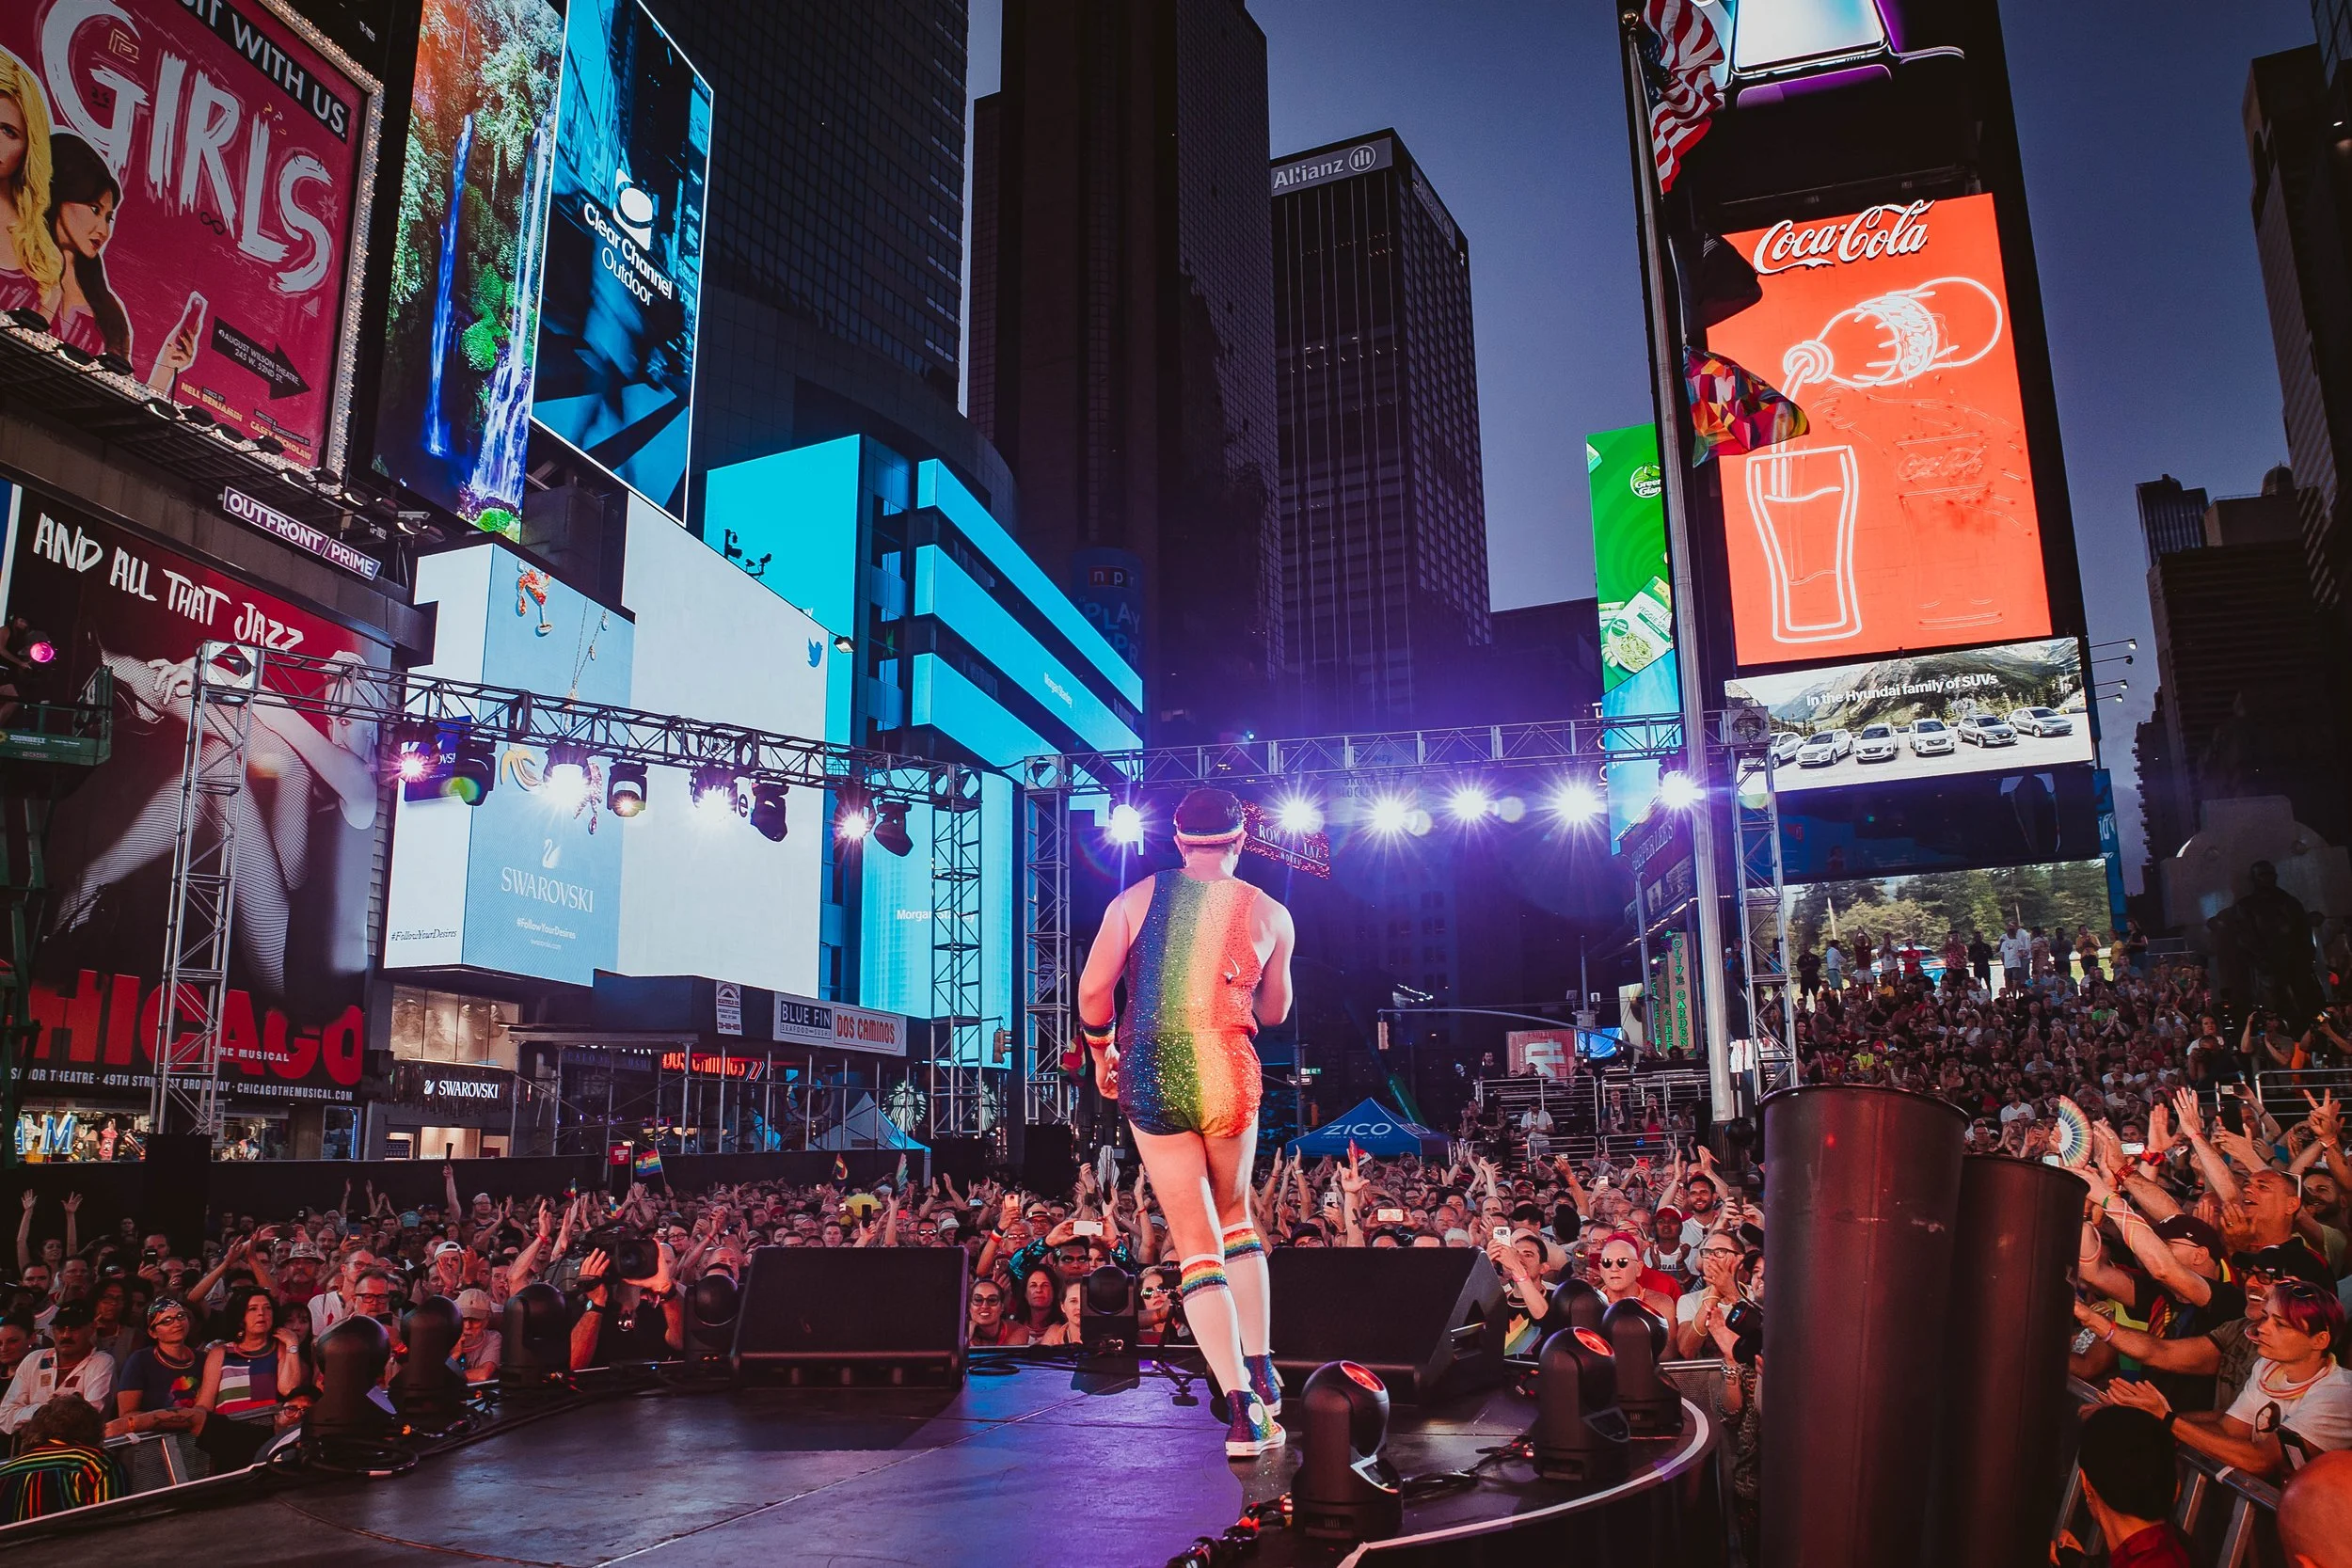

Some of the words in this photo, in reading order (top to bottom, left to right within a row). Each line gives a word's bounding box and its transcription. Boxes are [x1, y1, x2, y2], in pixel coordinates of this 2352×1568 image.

[232, 13, 306, 102] WITH
[313, 85, 346, 138] US.
[40, 0, 333, 293] GIRLS
[1274, 159, 1344, 189] Allianz
[583, 203, 621, 248] Clear
[621, 238, 673, 300] Channel
[601, 247, 653, 307] Outdoor
[224, 333, 249, 353] AUGUST
[250, 348, 276, 370] WILSON
[181, 382, 200, 399] NELL
[202, 394, 243, 422] BENJAMIN
[1639, 487, 1661, 496] Gian
[229, 493, 323, 551] OUTFRONT
[331, 543, 374, 577] PRIME
[34, 513, 103, 572] AND
[109, 546, 158, 602] ALL
[163, 568, 231, 626] THAT
[233, 602, 304, 652] JAZZ
[1806, 694, 1820, 706] In
[1820, 691, 1844, 705] the
[1845, 684, 1900, 703] Hyundai
[1901, 679, 1945, 694] family
[1945, 676, 1962, 689] of
[1961, 673, 1999, 688] SUVs
[501, 866, 595, 913] SWAROVSKI
[390, 928, 457, 942] #FollowYourDesires
[516, 917, 577, 940] #FollowYourDesires
[1672, 939, 1685, 985] OLIVE
[0, 958, 363, 1085] HICAGO
[782, 1004, 809, 1024] BLUE
[814, 1009, 831, 1029] FIN
[782, 1024, 808, 1035] SEAFOOD
[836, 1014, 854, 1038] DOS
[857, 1018, 895, 1044] CAMINOS
[1676, 990, 1689, 1047] GARDEN
[239, 1049, 289, 1062] MUSICAL
[50, 1069, 95, 1085] THEATRE
[103, 1074, 129, 1086] 49TH
[237, 1083, 353, 1101] CHICAGOTHEMUSICAL.COM
[438, 1080, 499, 1099] SWAROVSKI
[1323, 1122, 1392, 1135] ZICO
